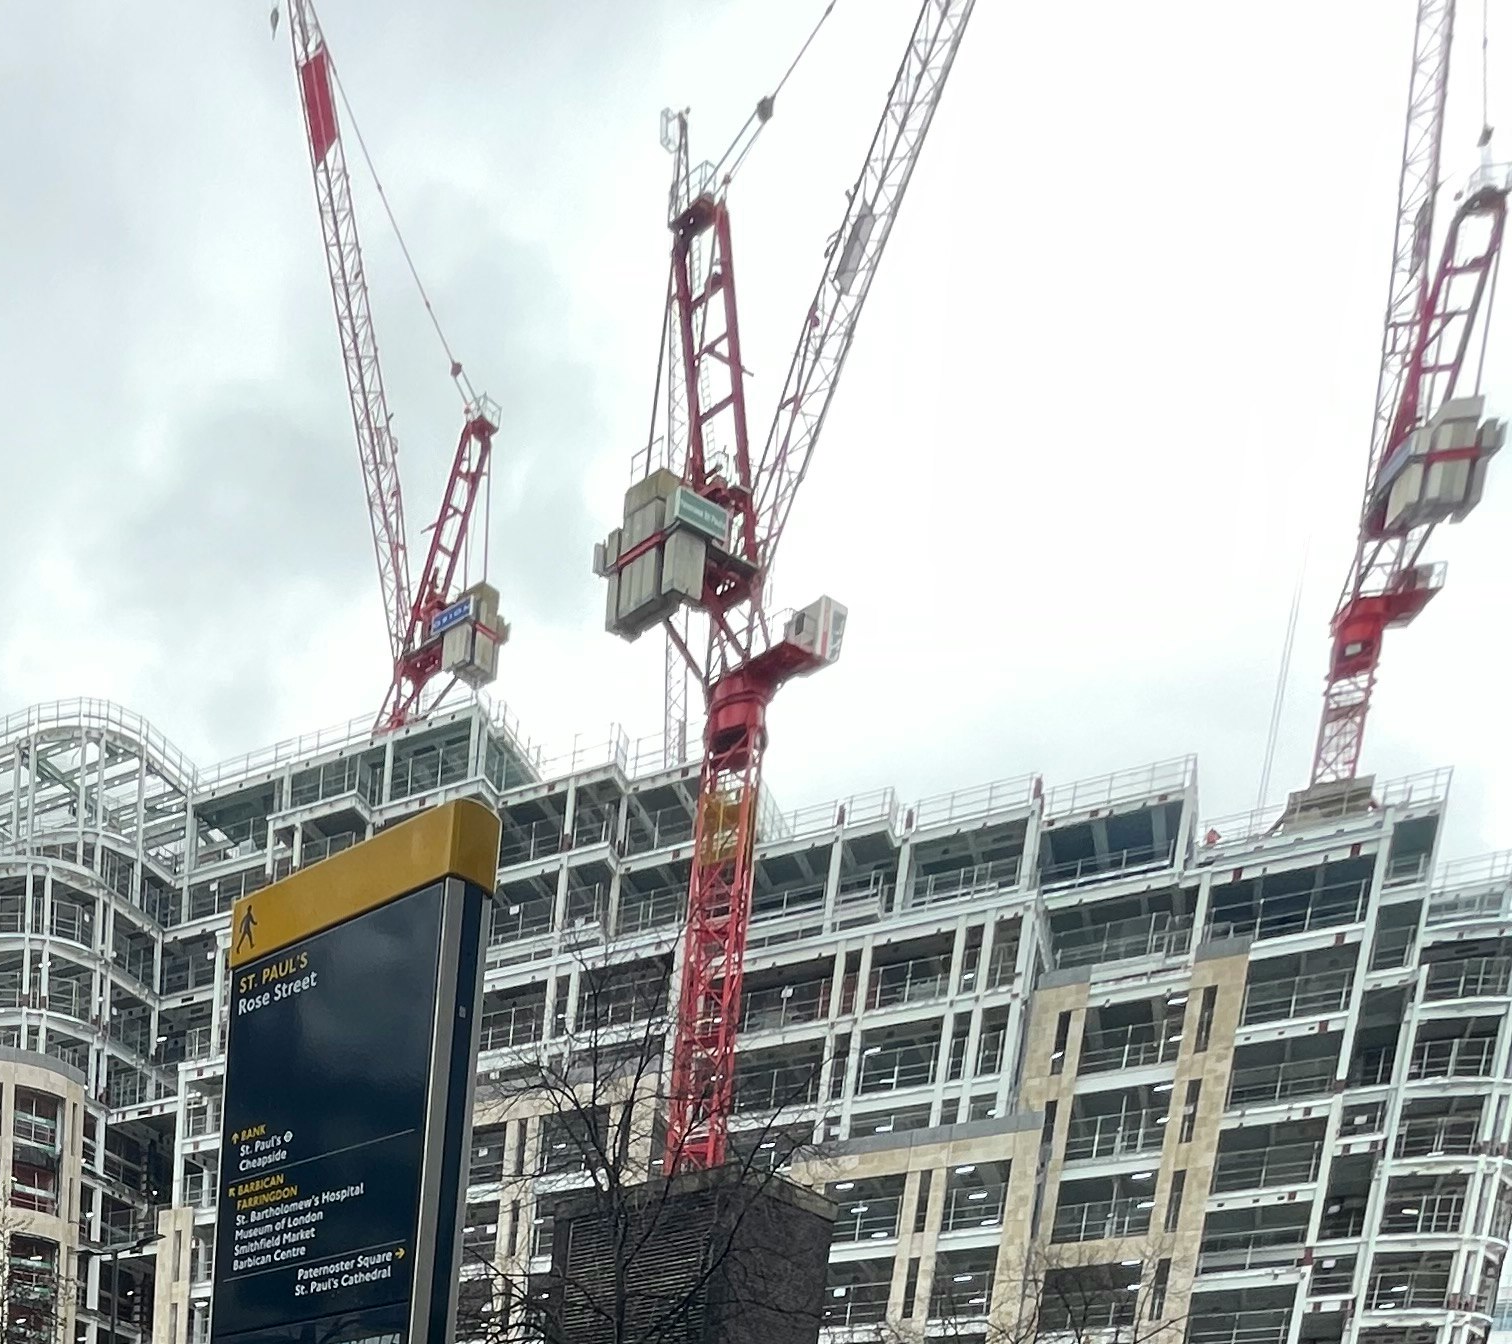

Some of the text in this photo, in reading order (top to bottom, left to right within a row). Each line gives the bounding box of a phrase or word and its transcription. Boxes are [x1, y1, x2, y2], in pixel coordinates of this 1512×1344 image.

[239, 952, 308, 994] ST. PAUL'S
[238, 971, 318, 1015] Rose Street
[240, 1135, 282, 1157] St. Paul's
[241, 1124, 266, 1141] BANK
[239, 1149, 287, 1171] Cheapside
[237, 1185, 298, 1210] FARRINGDON
[238, 1174, 284, 1195] BARBICAN
[236, 1182, 364, 1226] St. Bartholomew's Hospital
[235, 1211, 323, 1240] Museum of London
[234, 1227, 316, 1256] Smithfield Market
[233, 1246, 306, 1271] Barbican Centre
[297, 1251, 393, 1280] Paternoster Square
[294, 1265, 391, 1296] St. Paul's Cathedral
